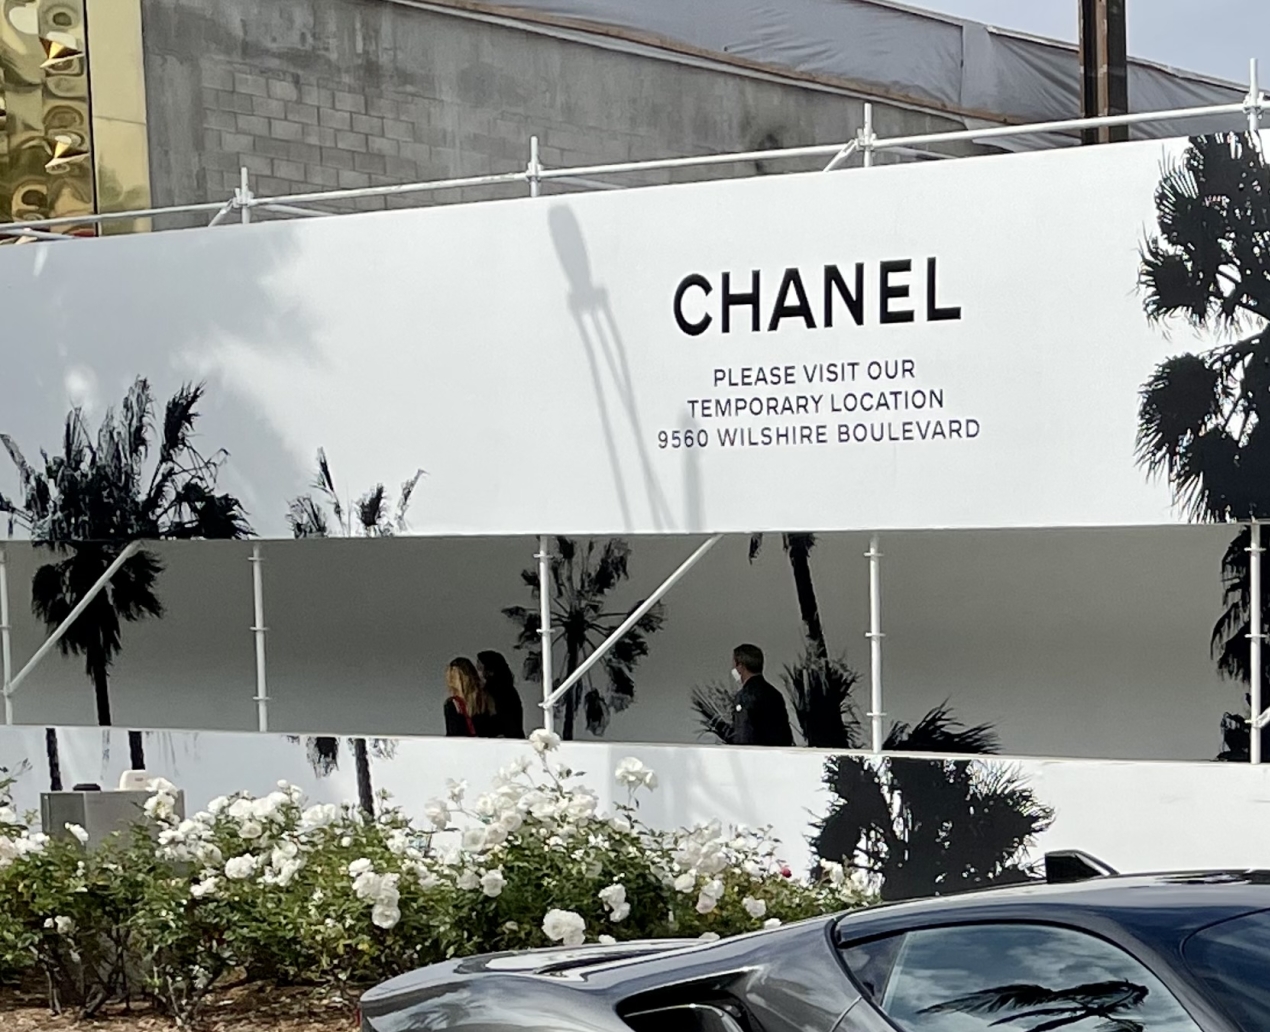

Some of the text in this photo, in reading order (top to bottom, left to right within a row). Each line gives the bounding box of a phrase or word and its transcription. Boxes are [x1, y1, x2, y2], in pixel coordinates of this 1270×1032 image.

[673, 256, 962, 337] CHANEL
[714, 358, 916, 387] PLEASE VISIT OUR
[687, 388, 945, 418] TEMPORARY LOCATION
[657, 418, 981, 449] 9560 WILSHIRE BOULEVARD
